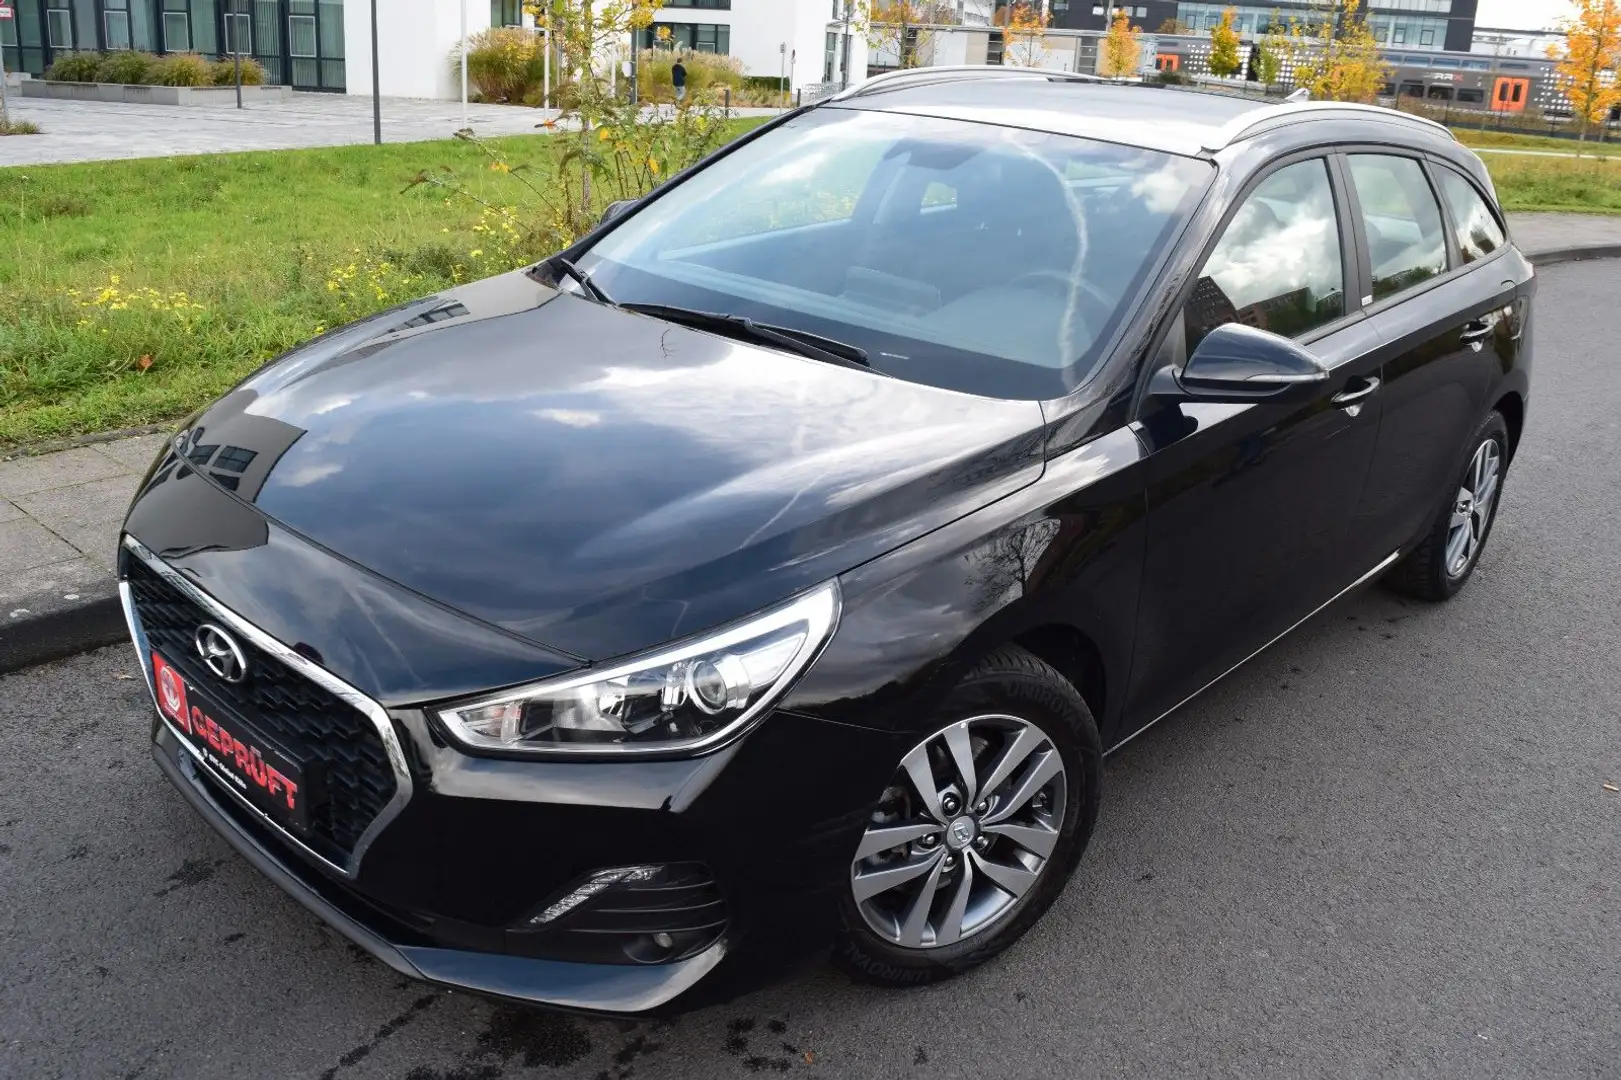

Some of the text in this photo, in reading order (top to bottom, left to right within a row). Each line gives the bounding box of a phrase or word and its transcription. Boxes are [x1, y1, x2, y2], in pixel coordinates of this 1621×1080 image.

[1006, 680, 1083, 735] UNIROYAL
[192, 706, 298, 809] GEPRÜFT
[844, 942, 931, 983] UNIROYAL
